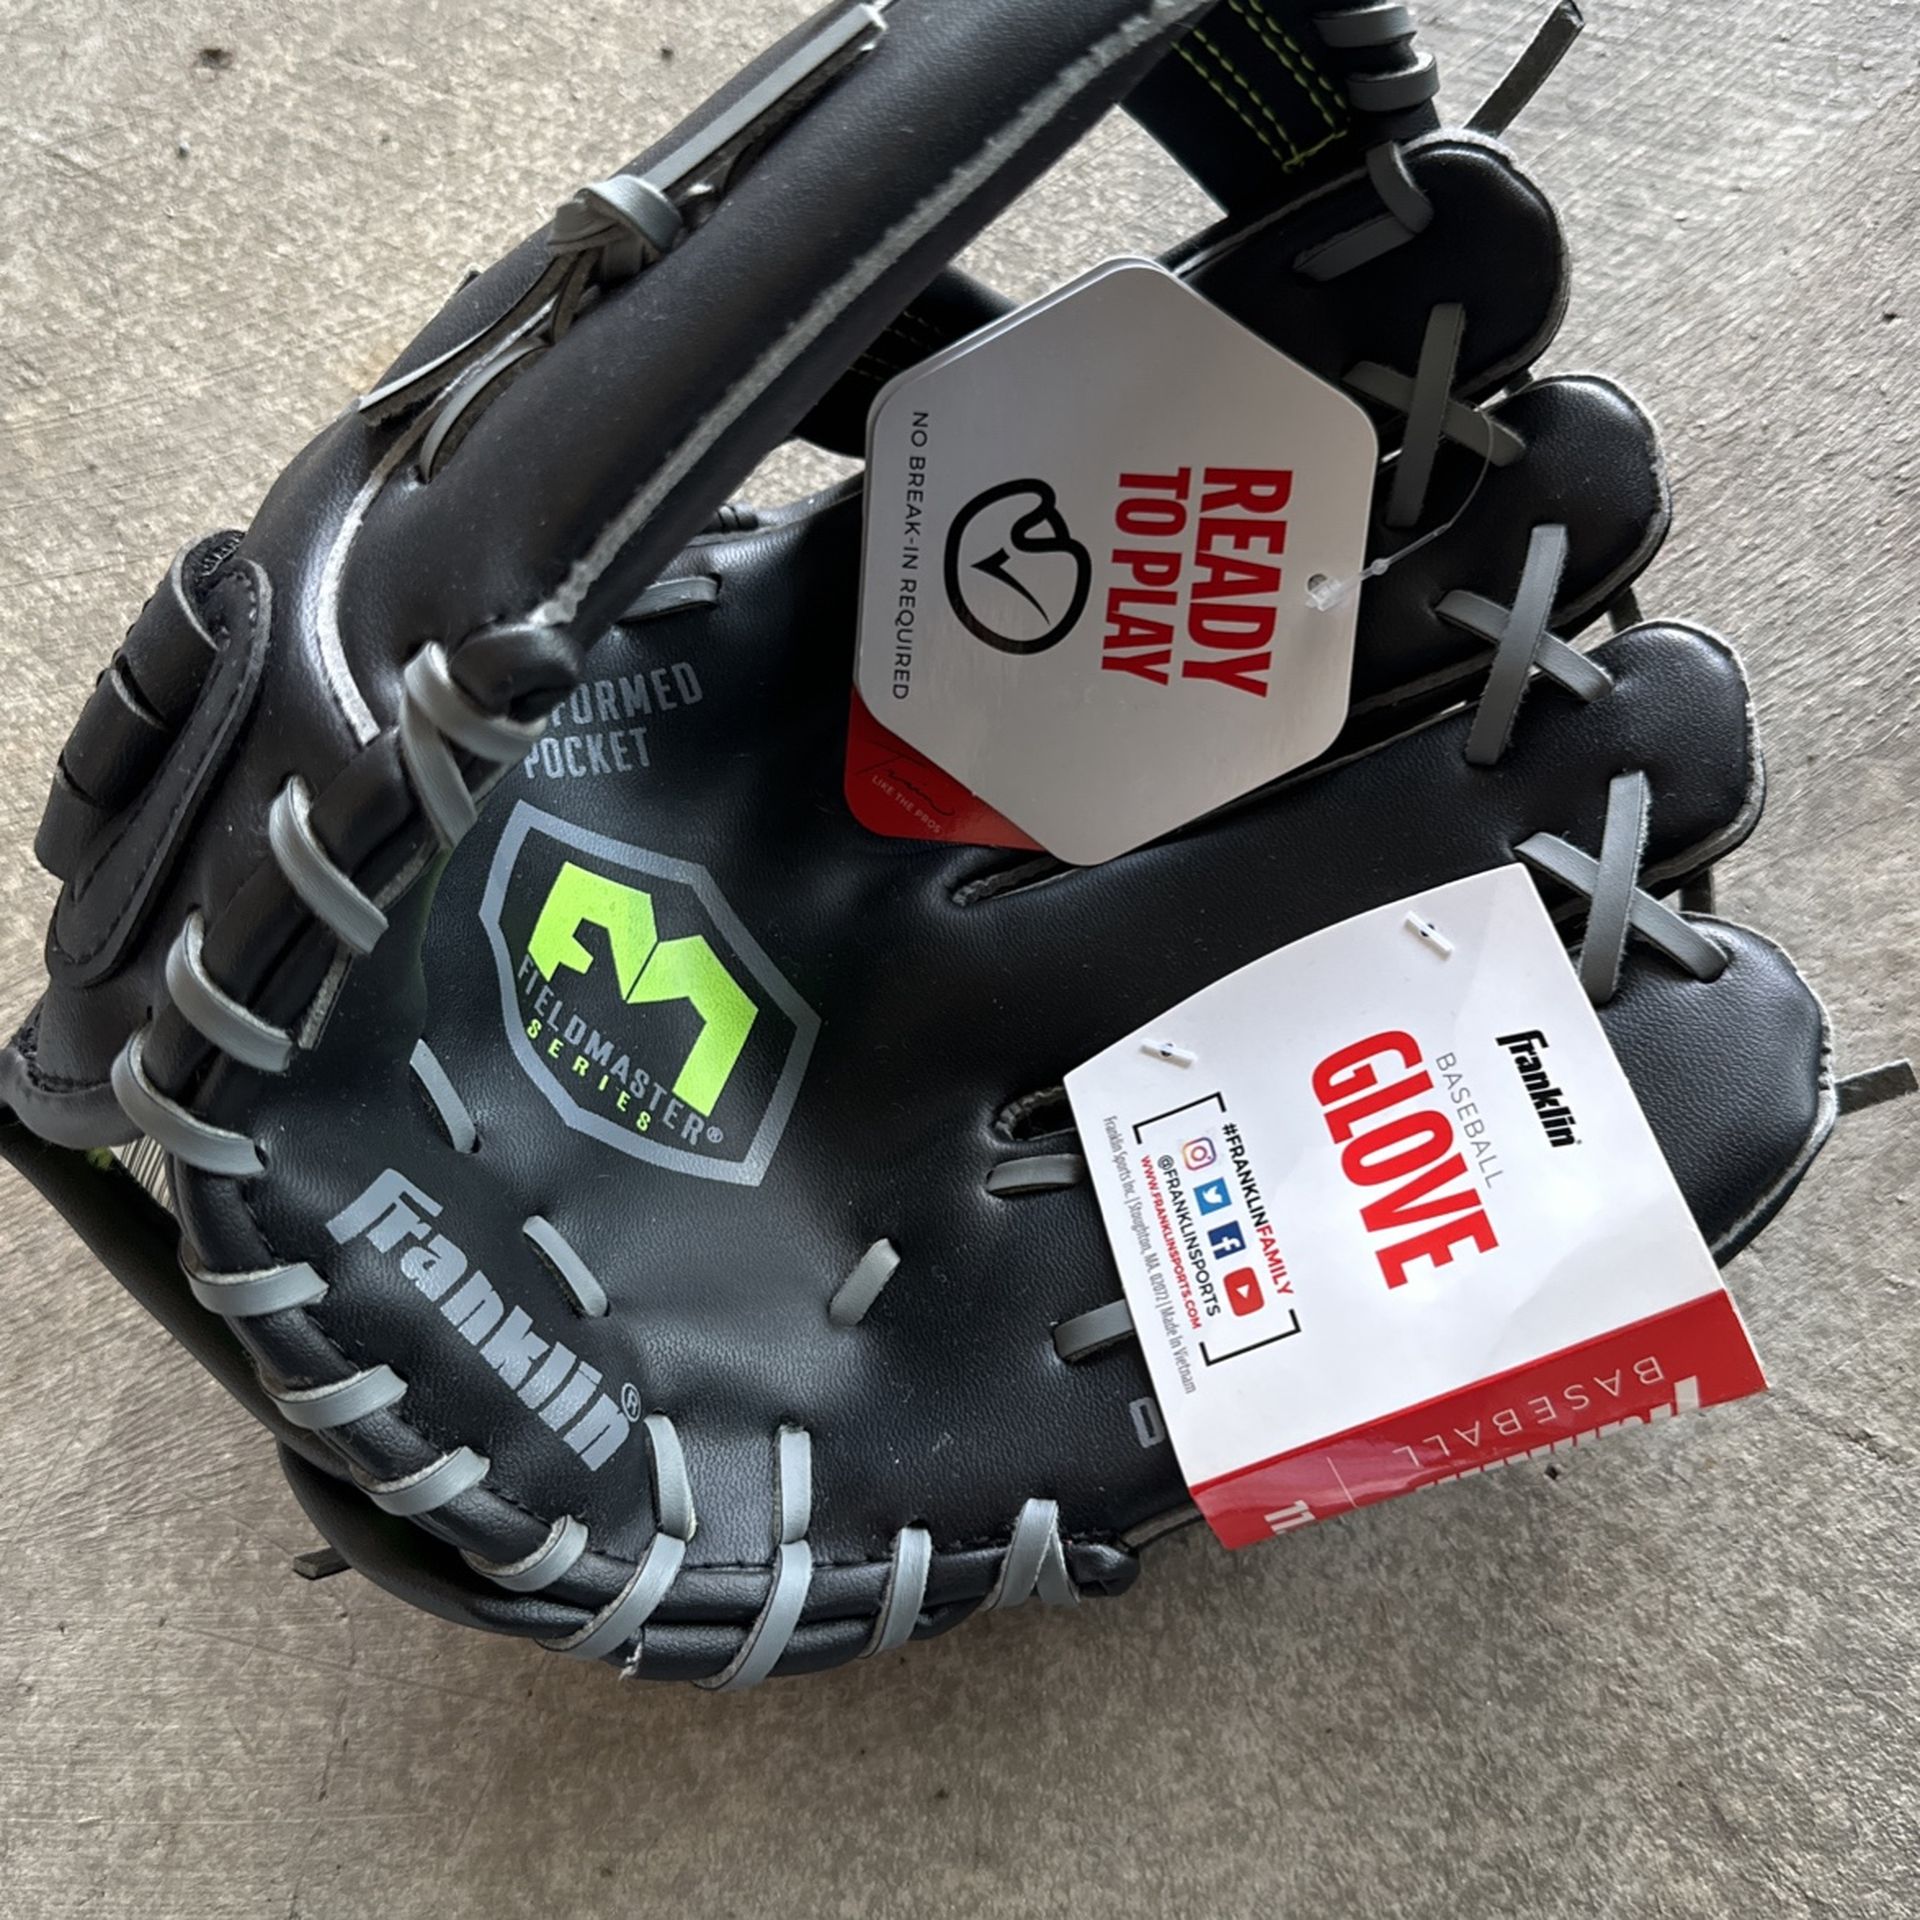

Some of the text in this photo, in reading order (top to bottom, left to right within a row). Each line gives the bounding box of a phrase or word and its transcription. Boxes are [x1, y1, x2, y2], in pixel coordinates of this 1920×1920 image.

[892, 411, 929, 700] NO BREAK-IN REQUIRED
[1101, 466, 1192, 687] TO PLAY
[1181, 467, 1294, 699] READY
[523, 727, 650, 770] POCKET
[871, 775, 942, 834] LIKE THE PROS
[526, 1018, 652, 1133] SERIES
[1435, 1051, 1504, 1189] BASEBALL
[1495, 1029, 1577, 1148] Franklin
[1103, 1115, 1124, 1152] Franklin
[1112, 1150, 1132, 1182] Sports
[1122, 1179, 1137, 1200] Inc.
[1311, 1030, 1500, 1290] GLOVE
[1128, 1201, 1152, 1256] Stoughton,
[1140, 1155, 1202, 1329] WWW.FRANKLINSPORTS.COM
[1157, 1154, 1221, 1317] @FRANKLINSPORTS
[1221, 1122, 1294, 1296] #FRANKLINFAMILY
[1149, 1271, 1170, 1304] 02072
[1160, 1305, 1178, 1337] Made
[1173, 1346, 1197, 1394] Vietnam
[1391, 1355, 1665, 1468] BASEBALL
